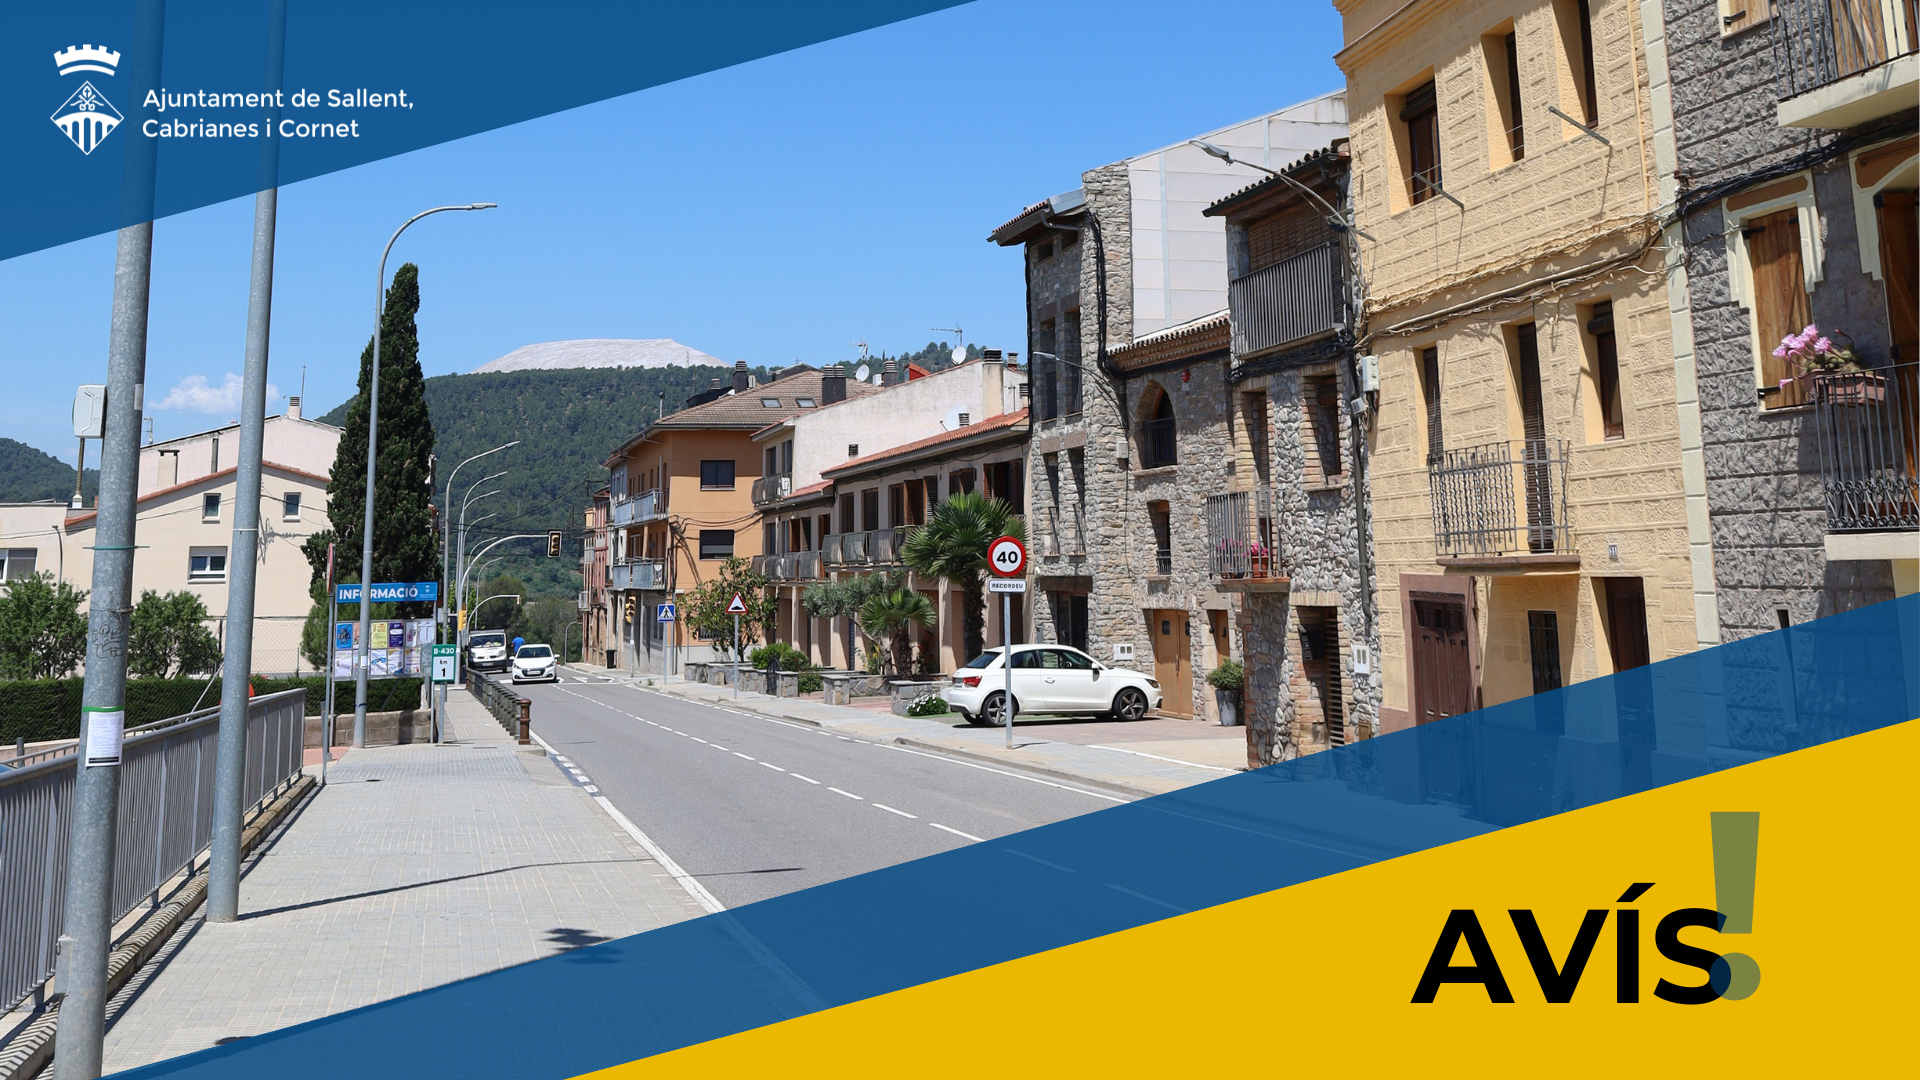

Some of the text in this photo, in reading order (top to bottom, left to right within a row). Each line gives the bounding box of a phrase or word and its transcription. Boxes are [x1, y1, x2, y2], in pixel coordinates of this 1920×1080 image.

[996, 551, 1018, 564] 40
[339, 585, 418, 600] INFRMACIÓ
[433, 647, 455, 655] B-430
[441, 667, 446, 677] 1
